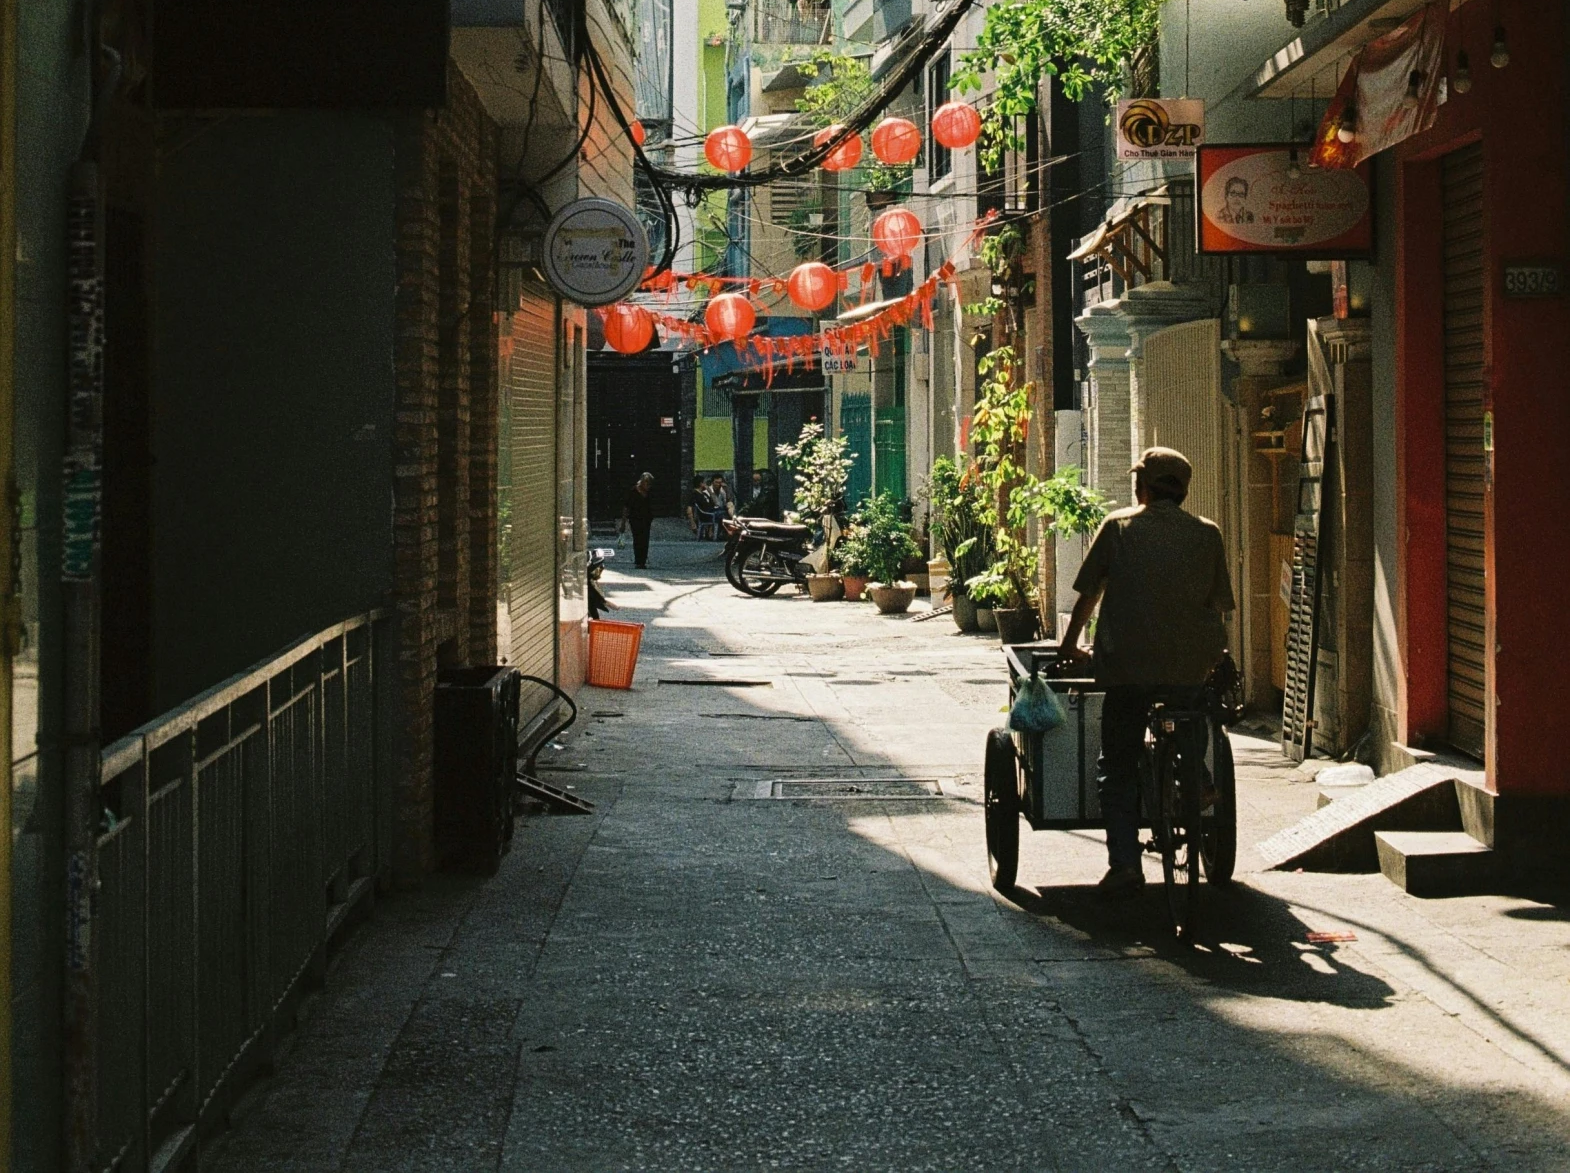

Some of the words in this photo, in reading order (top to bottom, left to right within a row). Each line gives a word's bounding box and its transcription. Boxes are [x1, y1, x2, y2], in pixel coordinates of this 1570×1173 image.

[1124, 149, 1139, 157] Cho
[1141, 148, 1158, 157] Thuê
[1160, 149, 1177, 157] Gian
[618, 239, 635, 249] The
[1506, 272, 1557, 292] 393/9
